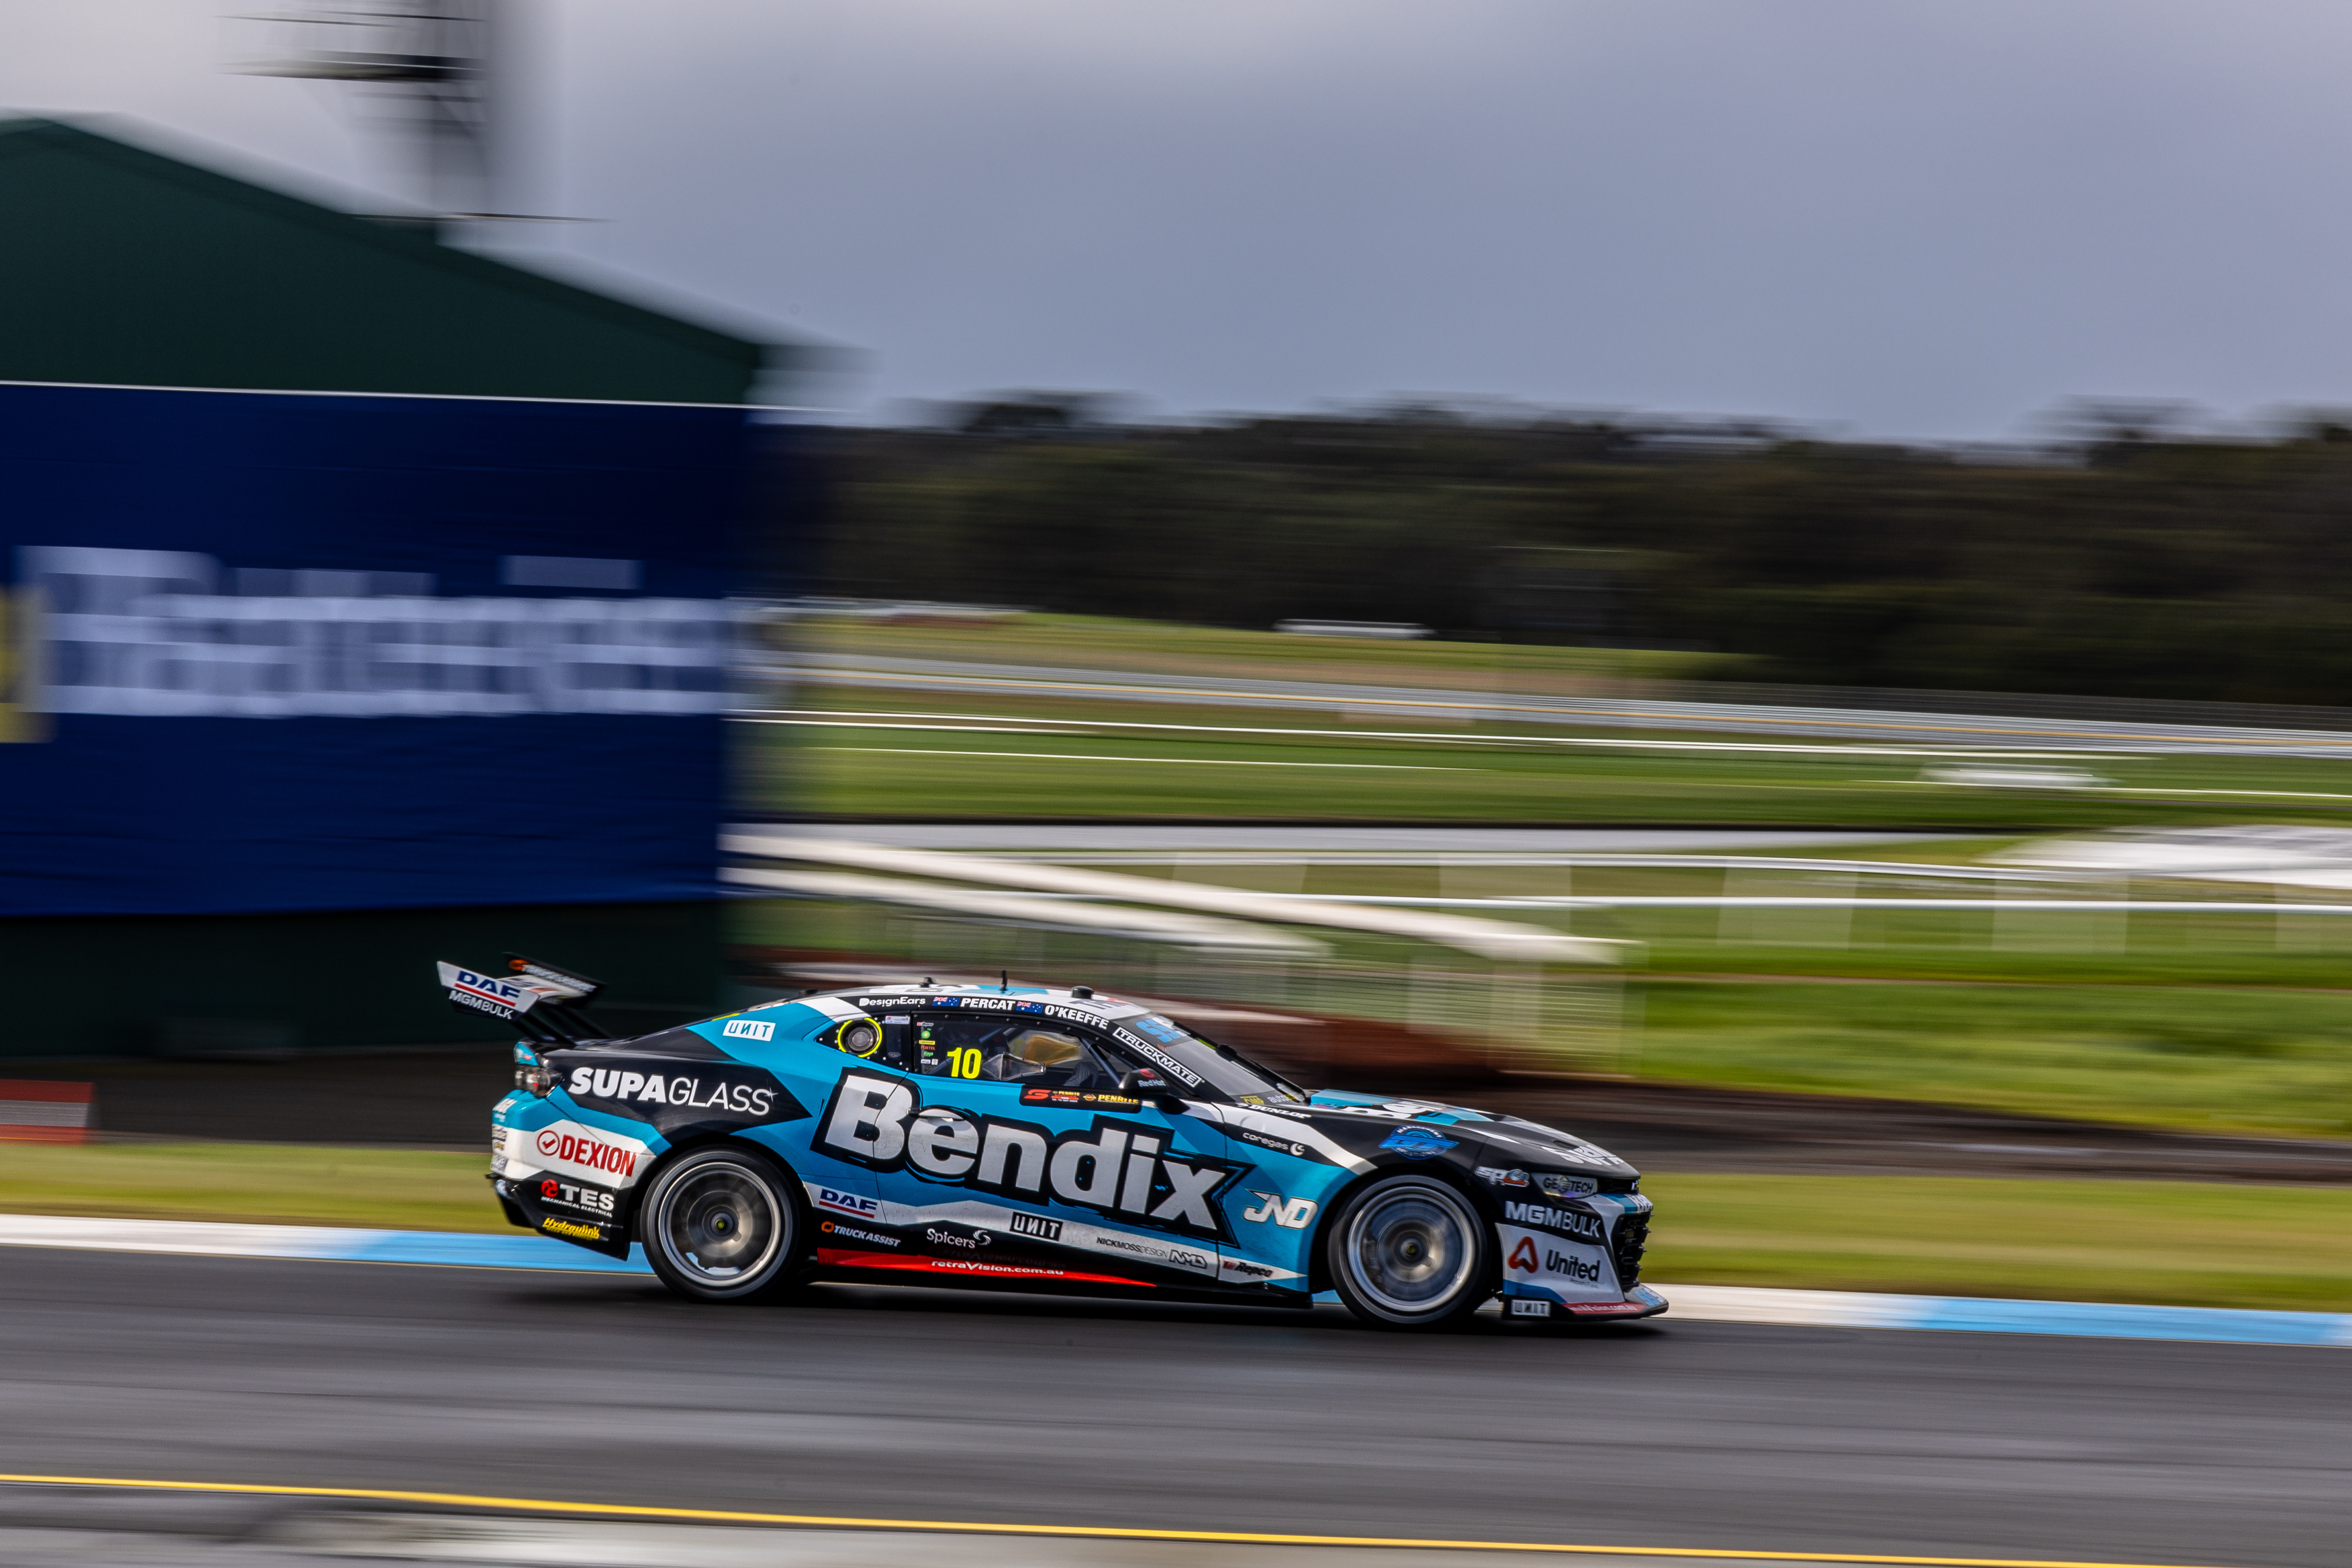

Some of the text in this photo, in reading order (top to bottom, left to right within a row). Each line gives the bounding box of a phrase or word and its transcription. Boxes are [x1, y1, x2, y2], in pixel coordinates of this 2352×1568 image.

[457, 970, 520, 998] DAF
[449, 990, 514, 1019] MGMBULK
[859, 997, 926, 1007] DesignEars
[960, 998, 1016, 1011] PERCAT
[1045, 1005, 1109, 1030] O'KEEFFE
[947, 1047, 982, 1079] 10
[1119, 1029, 1199, 1084] TRUCKMATE
[568, 1067, 770, 1116] SUPAGLASS
[1137, 1079, 1153, 1087] Red
[1248, 1104, 1312, 1119] DUNLOP
[559, 1134, 637, 1177] DEXION
[825, 1074, 1226, 1229] Bendix
[560, 1183, 614, 1211] TES
[819, 1188, 878, 1211] DAF
[1242, 1188, 1319, 1230] JND
[543, 1217, 600, 1239] Hydraulink
[1505, 1200, 1601, 1238] MGMBULK
[927, 1228, 976, 1249] Spicers
[931, 1259, 1064, 1276] retraVision.com.au
[1235, 1262, 1274, 1278] Repco
[1545, 1248, 1600, 1282] United
